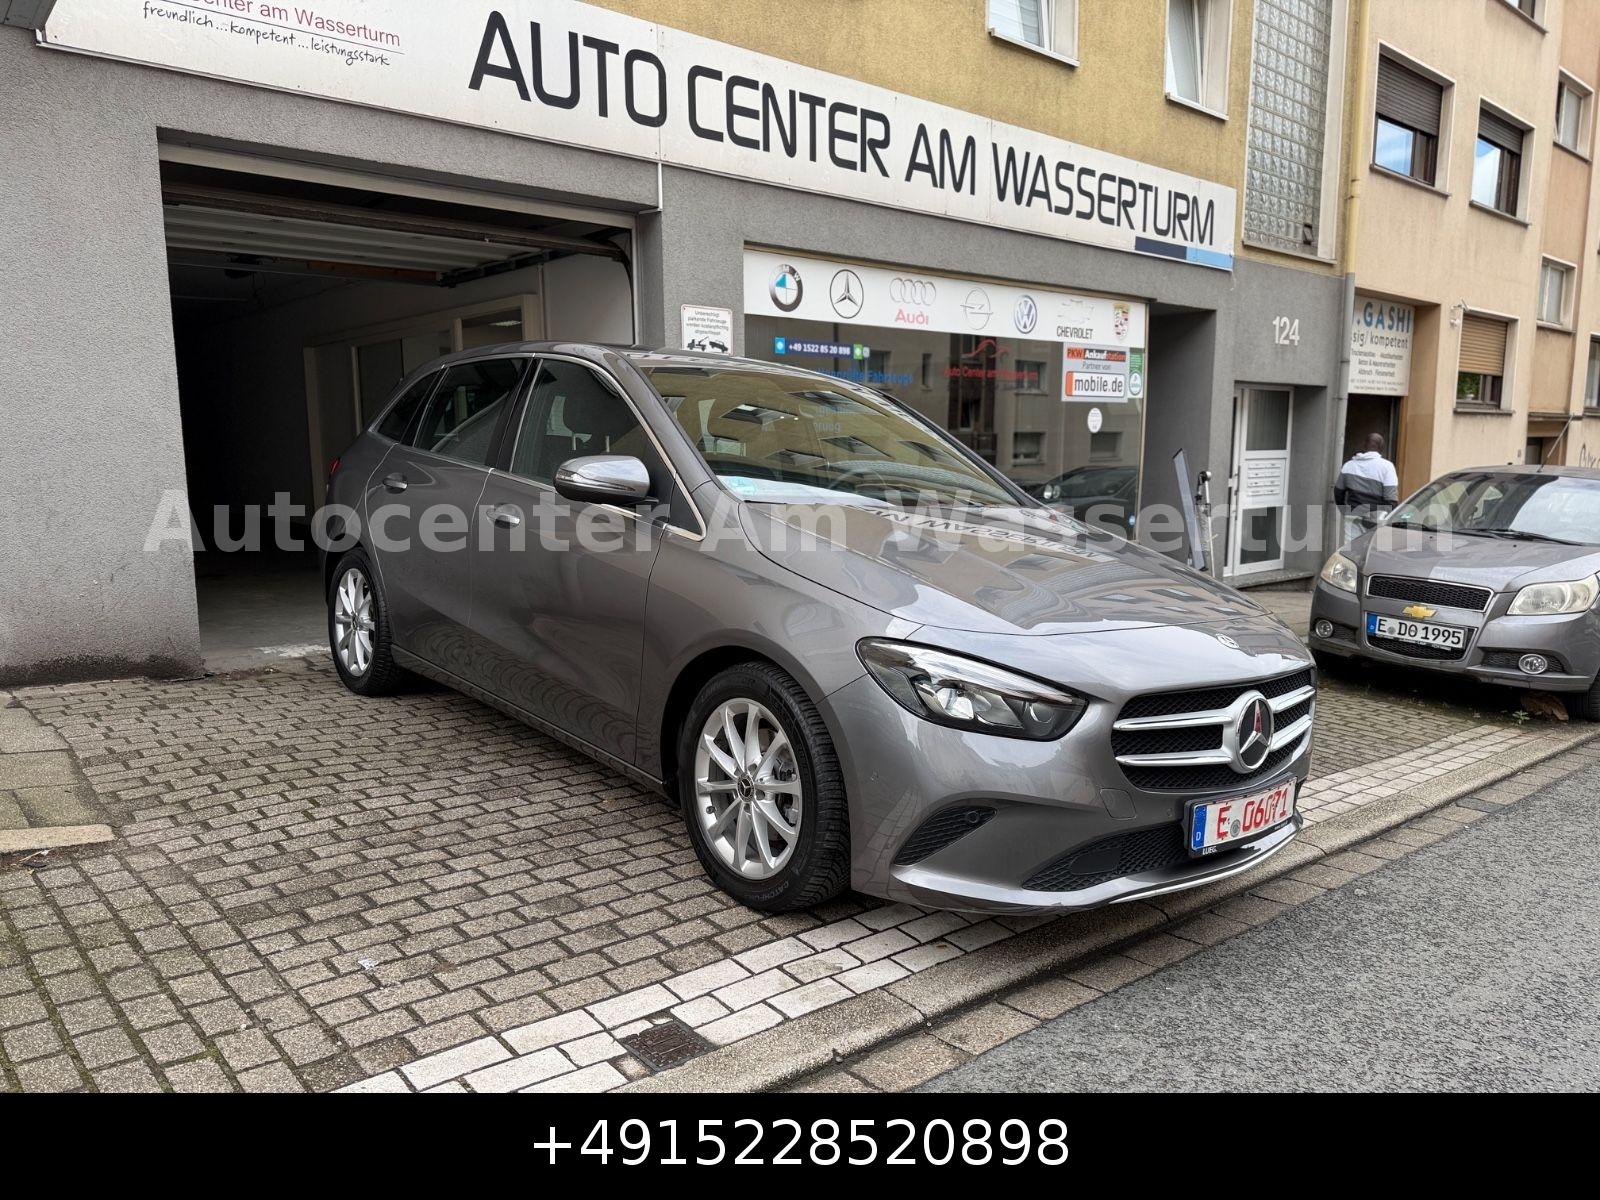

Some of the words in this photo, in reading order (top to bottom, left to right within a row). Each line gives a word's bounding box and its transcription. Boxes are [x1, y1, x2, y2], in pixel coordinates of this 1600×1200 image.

[260, 4, 288, 21] am
[294, 7, 400, 46] Wasserturm
[468, 10, 667, 128] AUTO
[687, 64, 891, 178] CENTER
[905, 123, 976, 196] AM
[992, 141, 1215, 247] WASSERTURM
[895, 309, 929, 325] Audi
[1353, 302, 1411, 333] .GASHI
[1056, 325, 1093, 340] CHEVROLET
[1273, 316, 1300, 346] 124
[803, 344, 819, 353] 1522
[829, 345, 838, 354] 20
[1067, 348, 1083, 359] PKW
[1074, 375, 1123, 393] mobile.de
[1378, 619, 1387, 633] E
[1420, 626, 1462, 645] 1995
[1195, 832, 1202, 841] D
[1216, 805, 1232, 839] E
[1242, 788, 1288, 832] 06071
